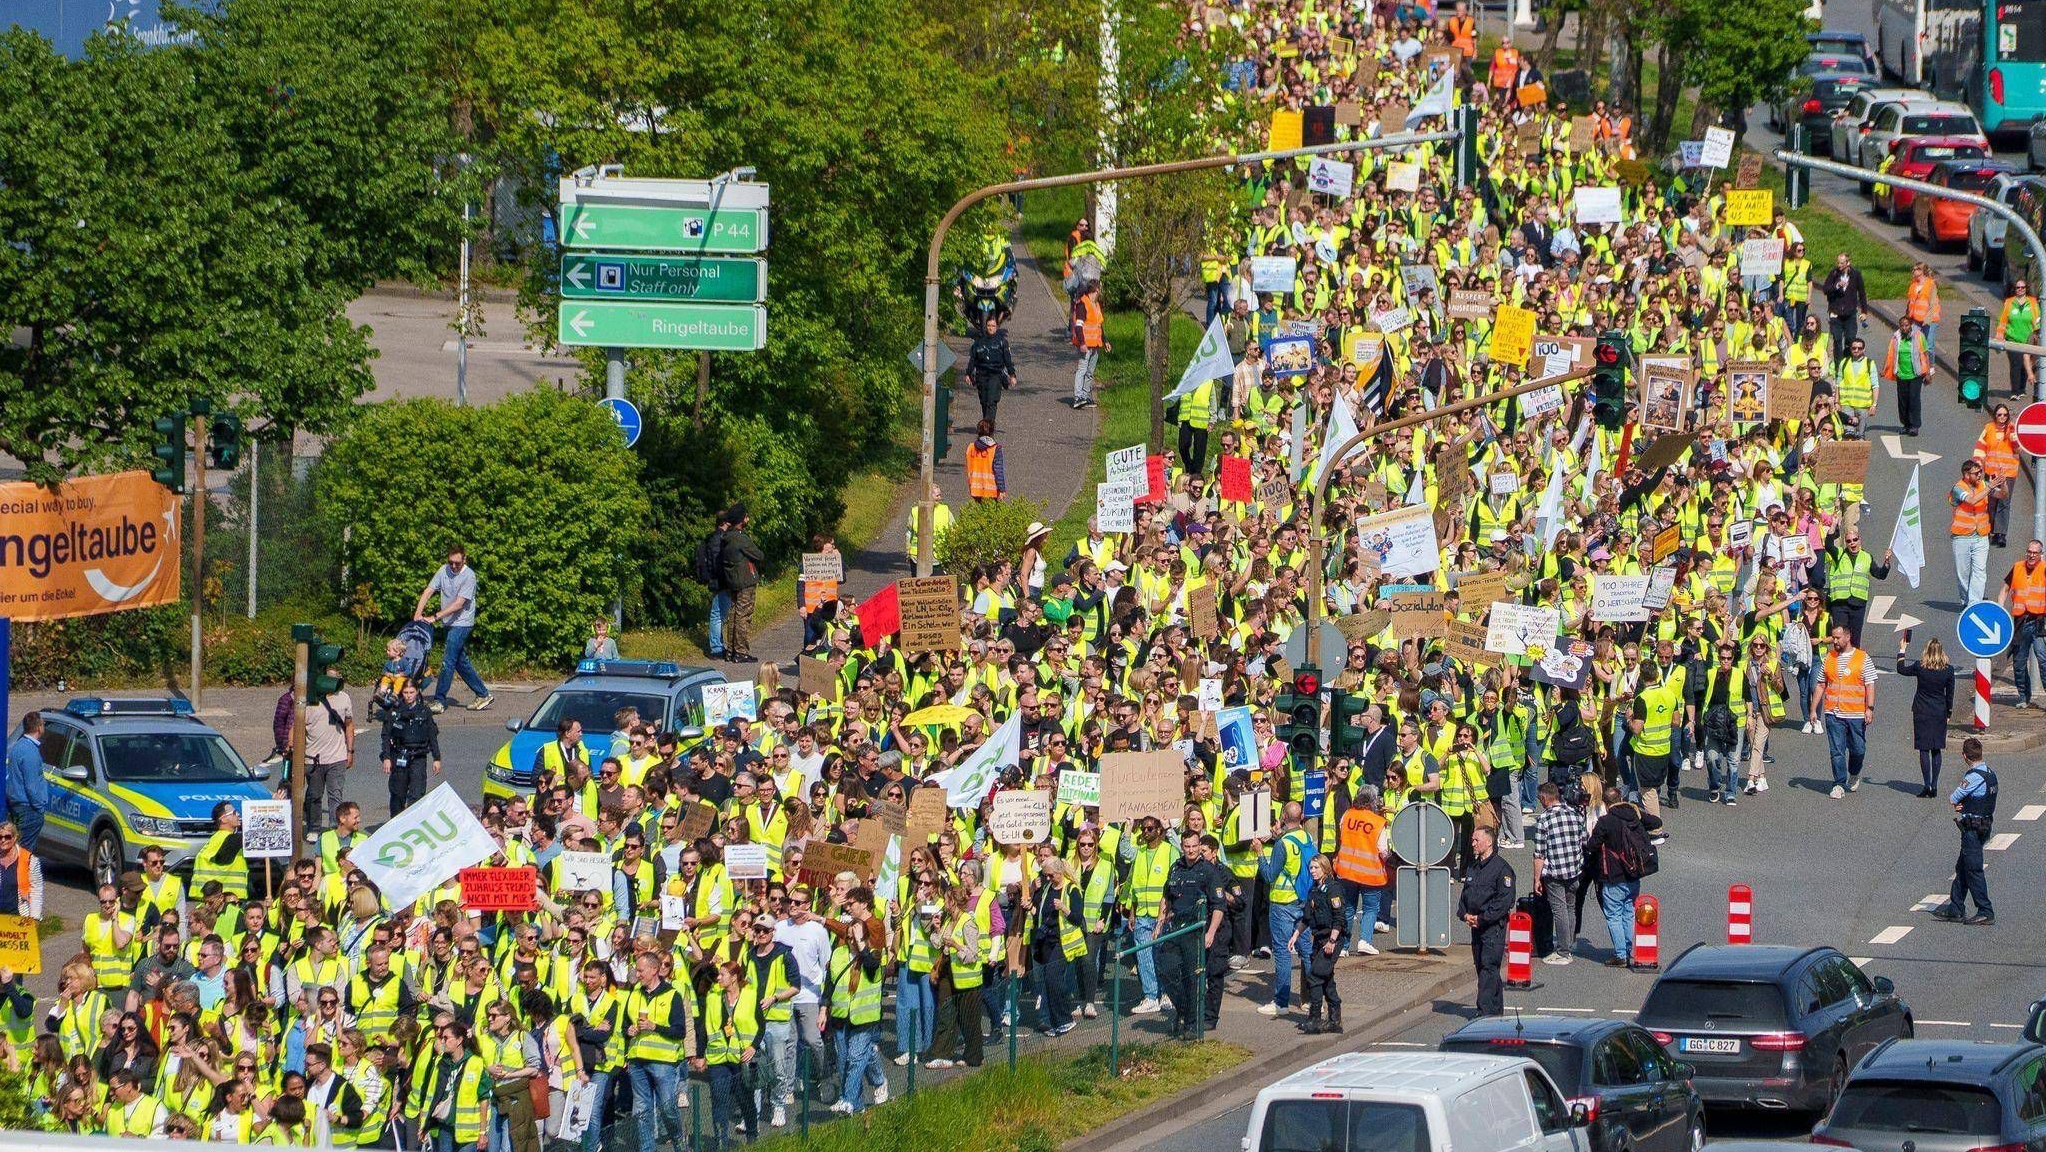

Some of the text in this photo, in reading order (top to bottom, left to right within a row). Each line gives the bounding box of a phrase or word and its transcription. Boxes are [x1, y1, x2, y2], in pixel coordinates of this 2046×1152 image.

[714, 223, 750, 238] P 44
[629, 263, 720, 278] Nur Personal
[629, 280, 699, 297] Staff only
[652, 318, 748, 337] Ringeltaube
[1291, 322, 1310, 331] Ohne
[1538, 342, 1559, 355] 100
[1113, 447, 1142, 465] GUTE
[0, 497, 97, 515] ecial way to buy.
[1101, 508, 1133, 516] ZUKUNFT
[0, 515, 156, 578] ngeltaube
[1601, 580, 1644, 590] 100 JAHRE
[20, 592, 39, 603] um
[41, 590, 54, 602] die
[178, 794, 250, 802] POLIZEI
[1119, 799, 1181, 814] MANAGEMENT
[1005, 820, 1022, 828] Gold
[830, 847, 871, 867] GIER
[463, 871, 487, 882] IMMER
[464, 882, 504, 893] ZUHAUSE
[467, 893, 490, 904] NICHT
[494, 893, 508, 904] MIT
[1689, 1038, 1736, 1051] GG C 827
